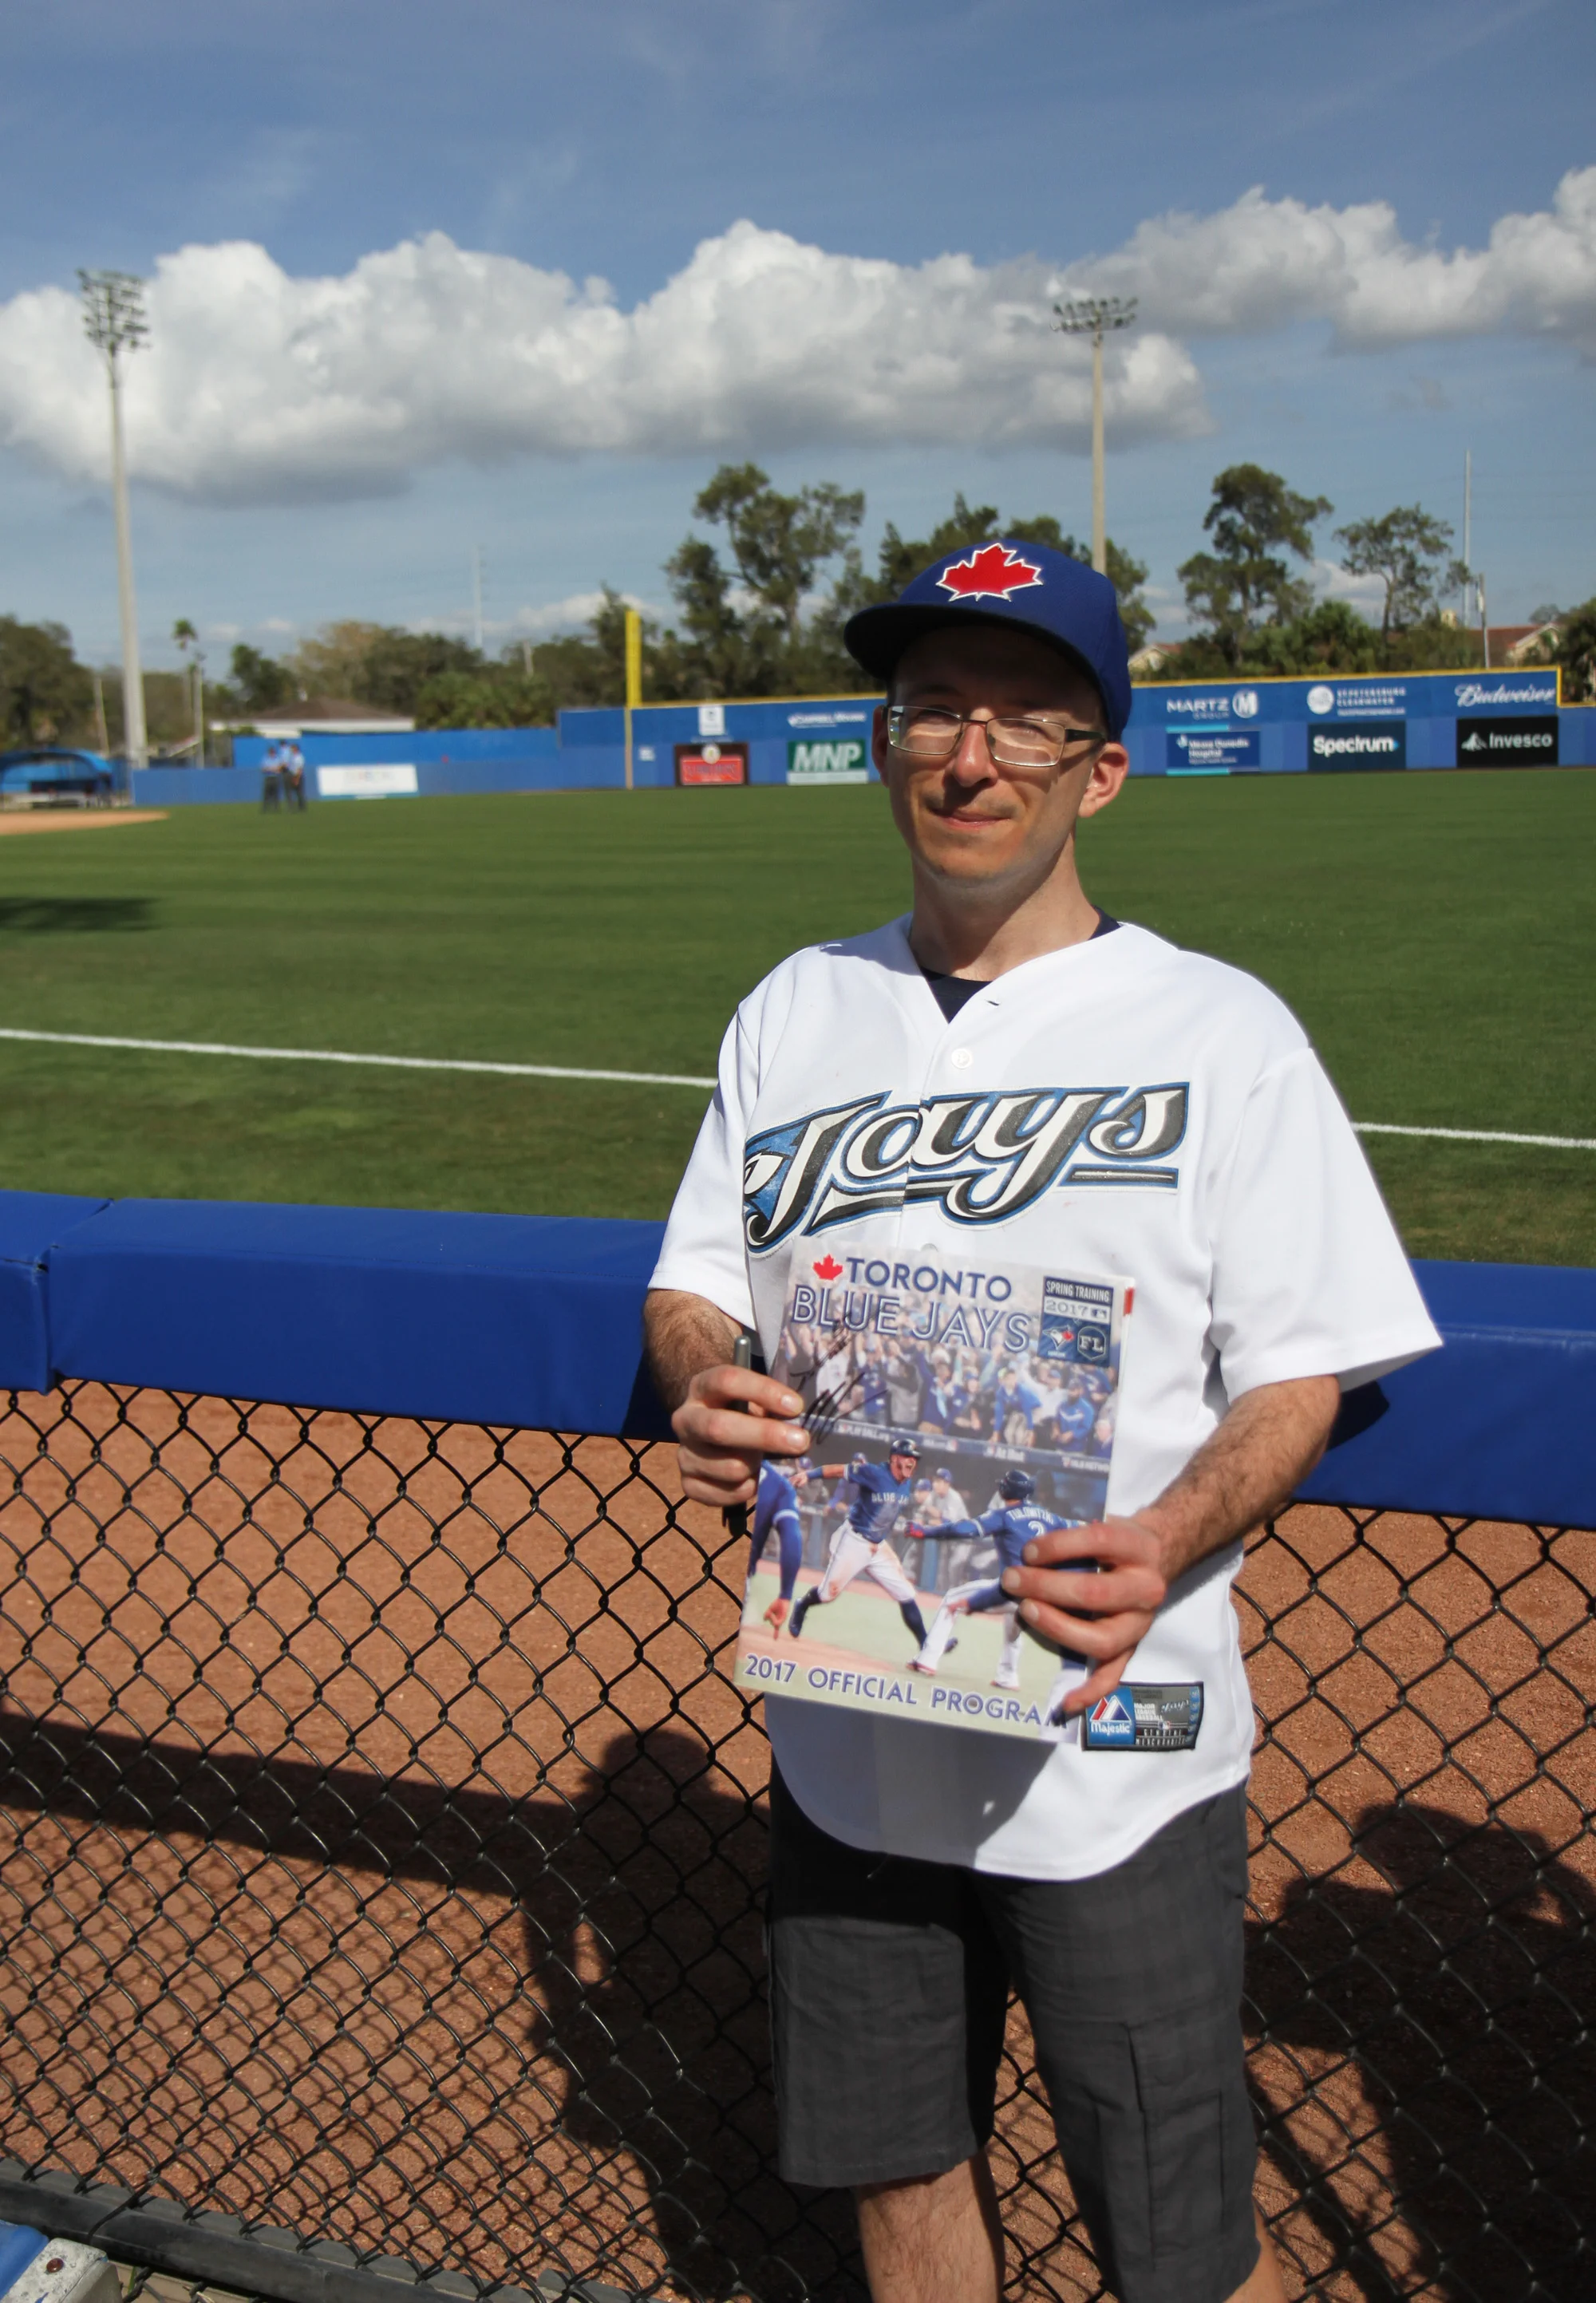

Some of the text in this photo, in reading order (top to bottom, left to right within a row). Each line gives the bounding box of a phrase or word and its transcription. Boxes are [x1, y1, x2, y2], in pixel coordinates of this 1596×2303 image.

[1167, 697, 1229, 713] MARTZ
[1454, 683, 1555, 707] Budweiser
[1314, 735, 1394, 757] Spectrum
[1489, 732, 1553, 749] Invesco
[792, 742, 862, 772] MNP
[744, 1081, 1190, 1256] Jays
[845, 1256, 1012, 1302] TORONTO
[1045, 1281, 1109, 1302] SPRING TRAINING
[791, 1284, 1032, 1353] BLUE JAYS
[1045, 1299, 1087, 1316] 2017
[1079, 1335, 1104, 1353] FL
[745, 1653, 797, 1684] 2017
[808, 1666, 918, 1705] OFFICIAL
[1091, 1721, 1131, 1736] Majestic
